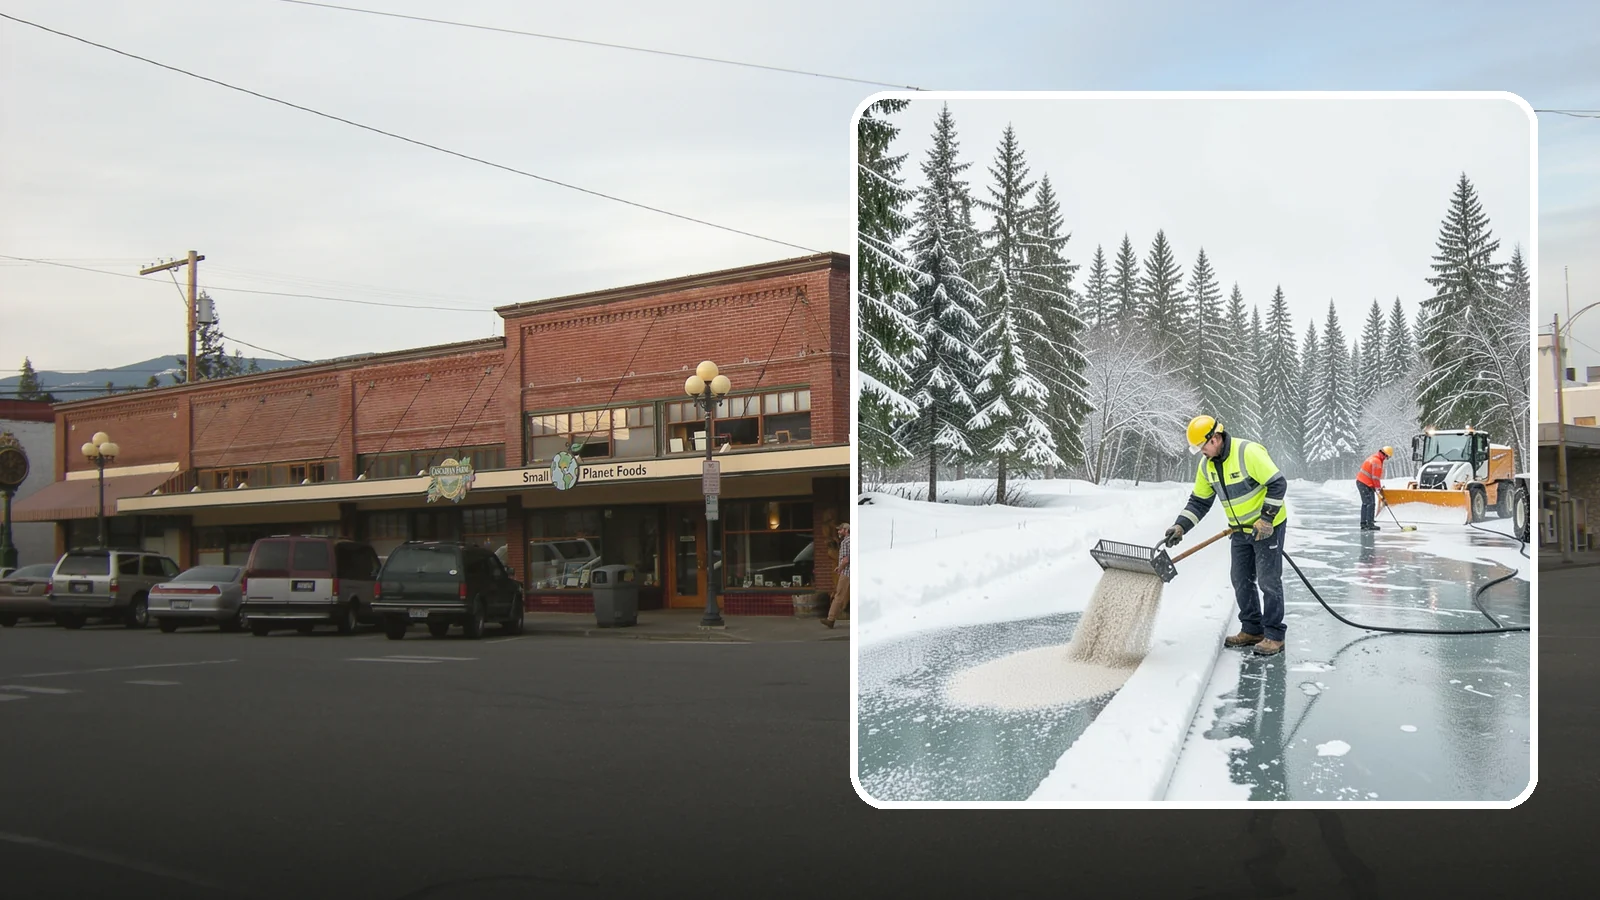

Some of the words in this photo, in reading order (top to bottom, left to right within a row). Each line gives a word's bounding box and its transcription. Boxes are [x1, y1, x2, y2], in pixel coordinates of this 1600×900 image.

[523, 471, 549, 483] Small
[583, 467, 614, 479] Planet
[617, 464, 647, 477] Foods
